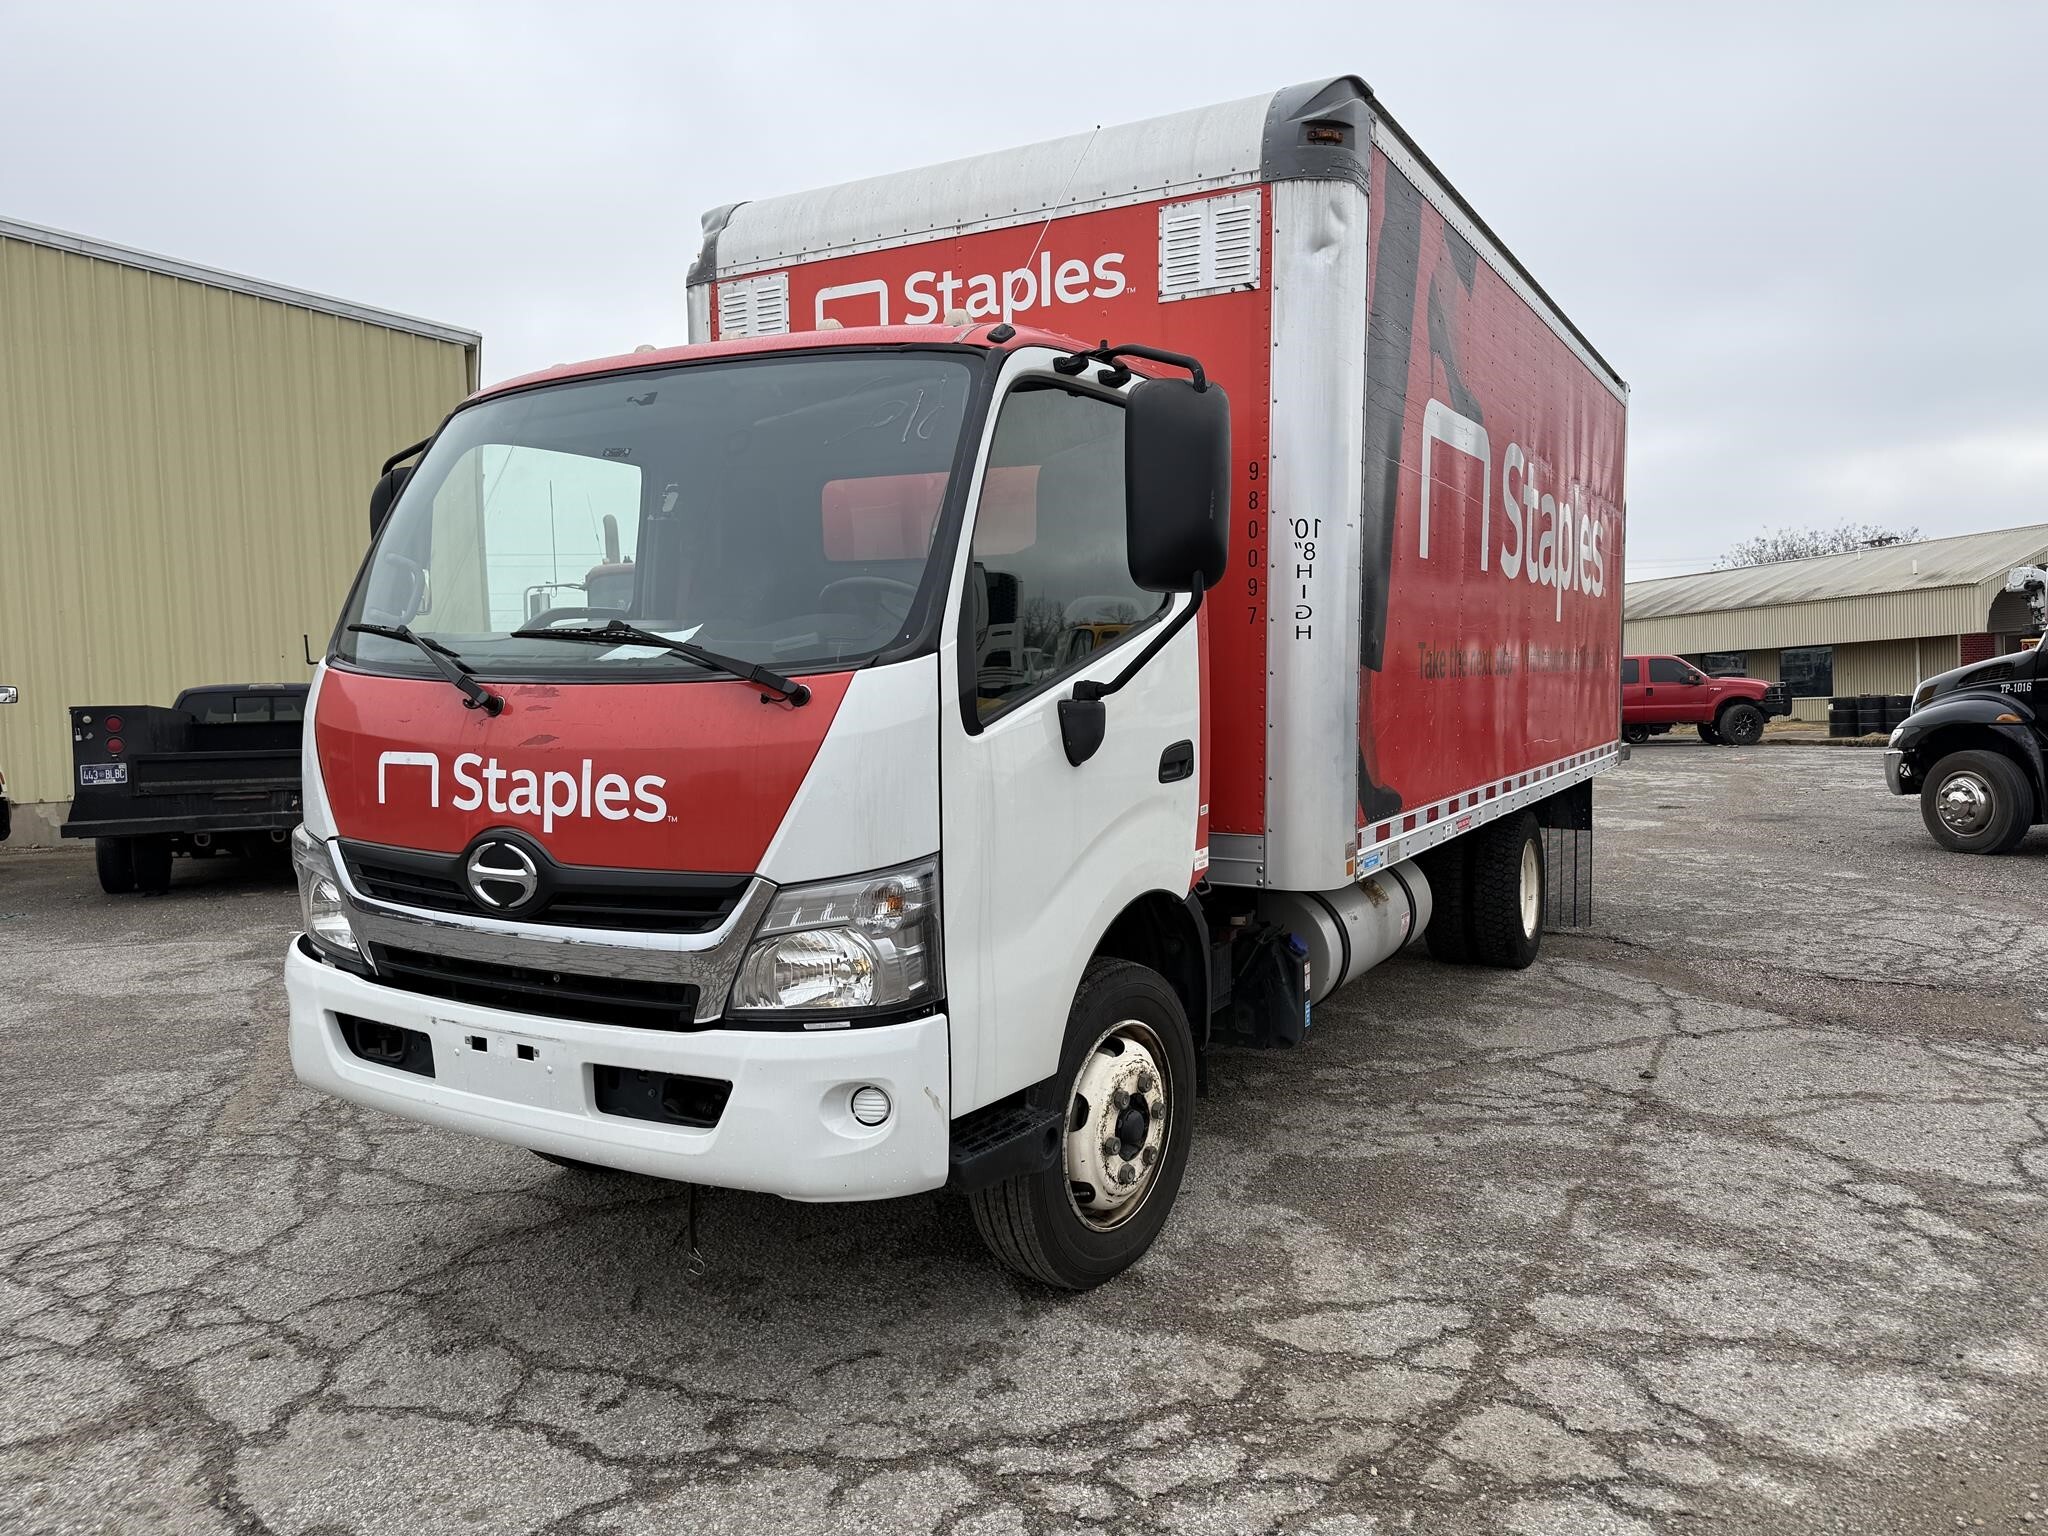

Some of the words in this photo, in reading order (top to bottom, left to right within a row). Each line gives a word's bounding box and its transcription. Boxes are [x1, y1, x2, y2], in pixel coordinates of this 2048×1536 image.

[904, 250, 1126, 325] Staples
[1248, 461, 1259, 625] 980097
[1500, 442, 1604, 622] Staples
[1418, 641, 1445, 680] Take
[1450, 640, 1467, 678] the
[2000, 682, 2032, 693] TP-1016
[83, 770, 99, 780] 443
[452, 752, 667, 833] Staples
